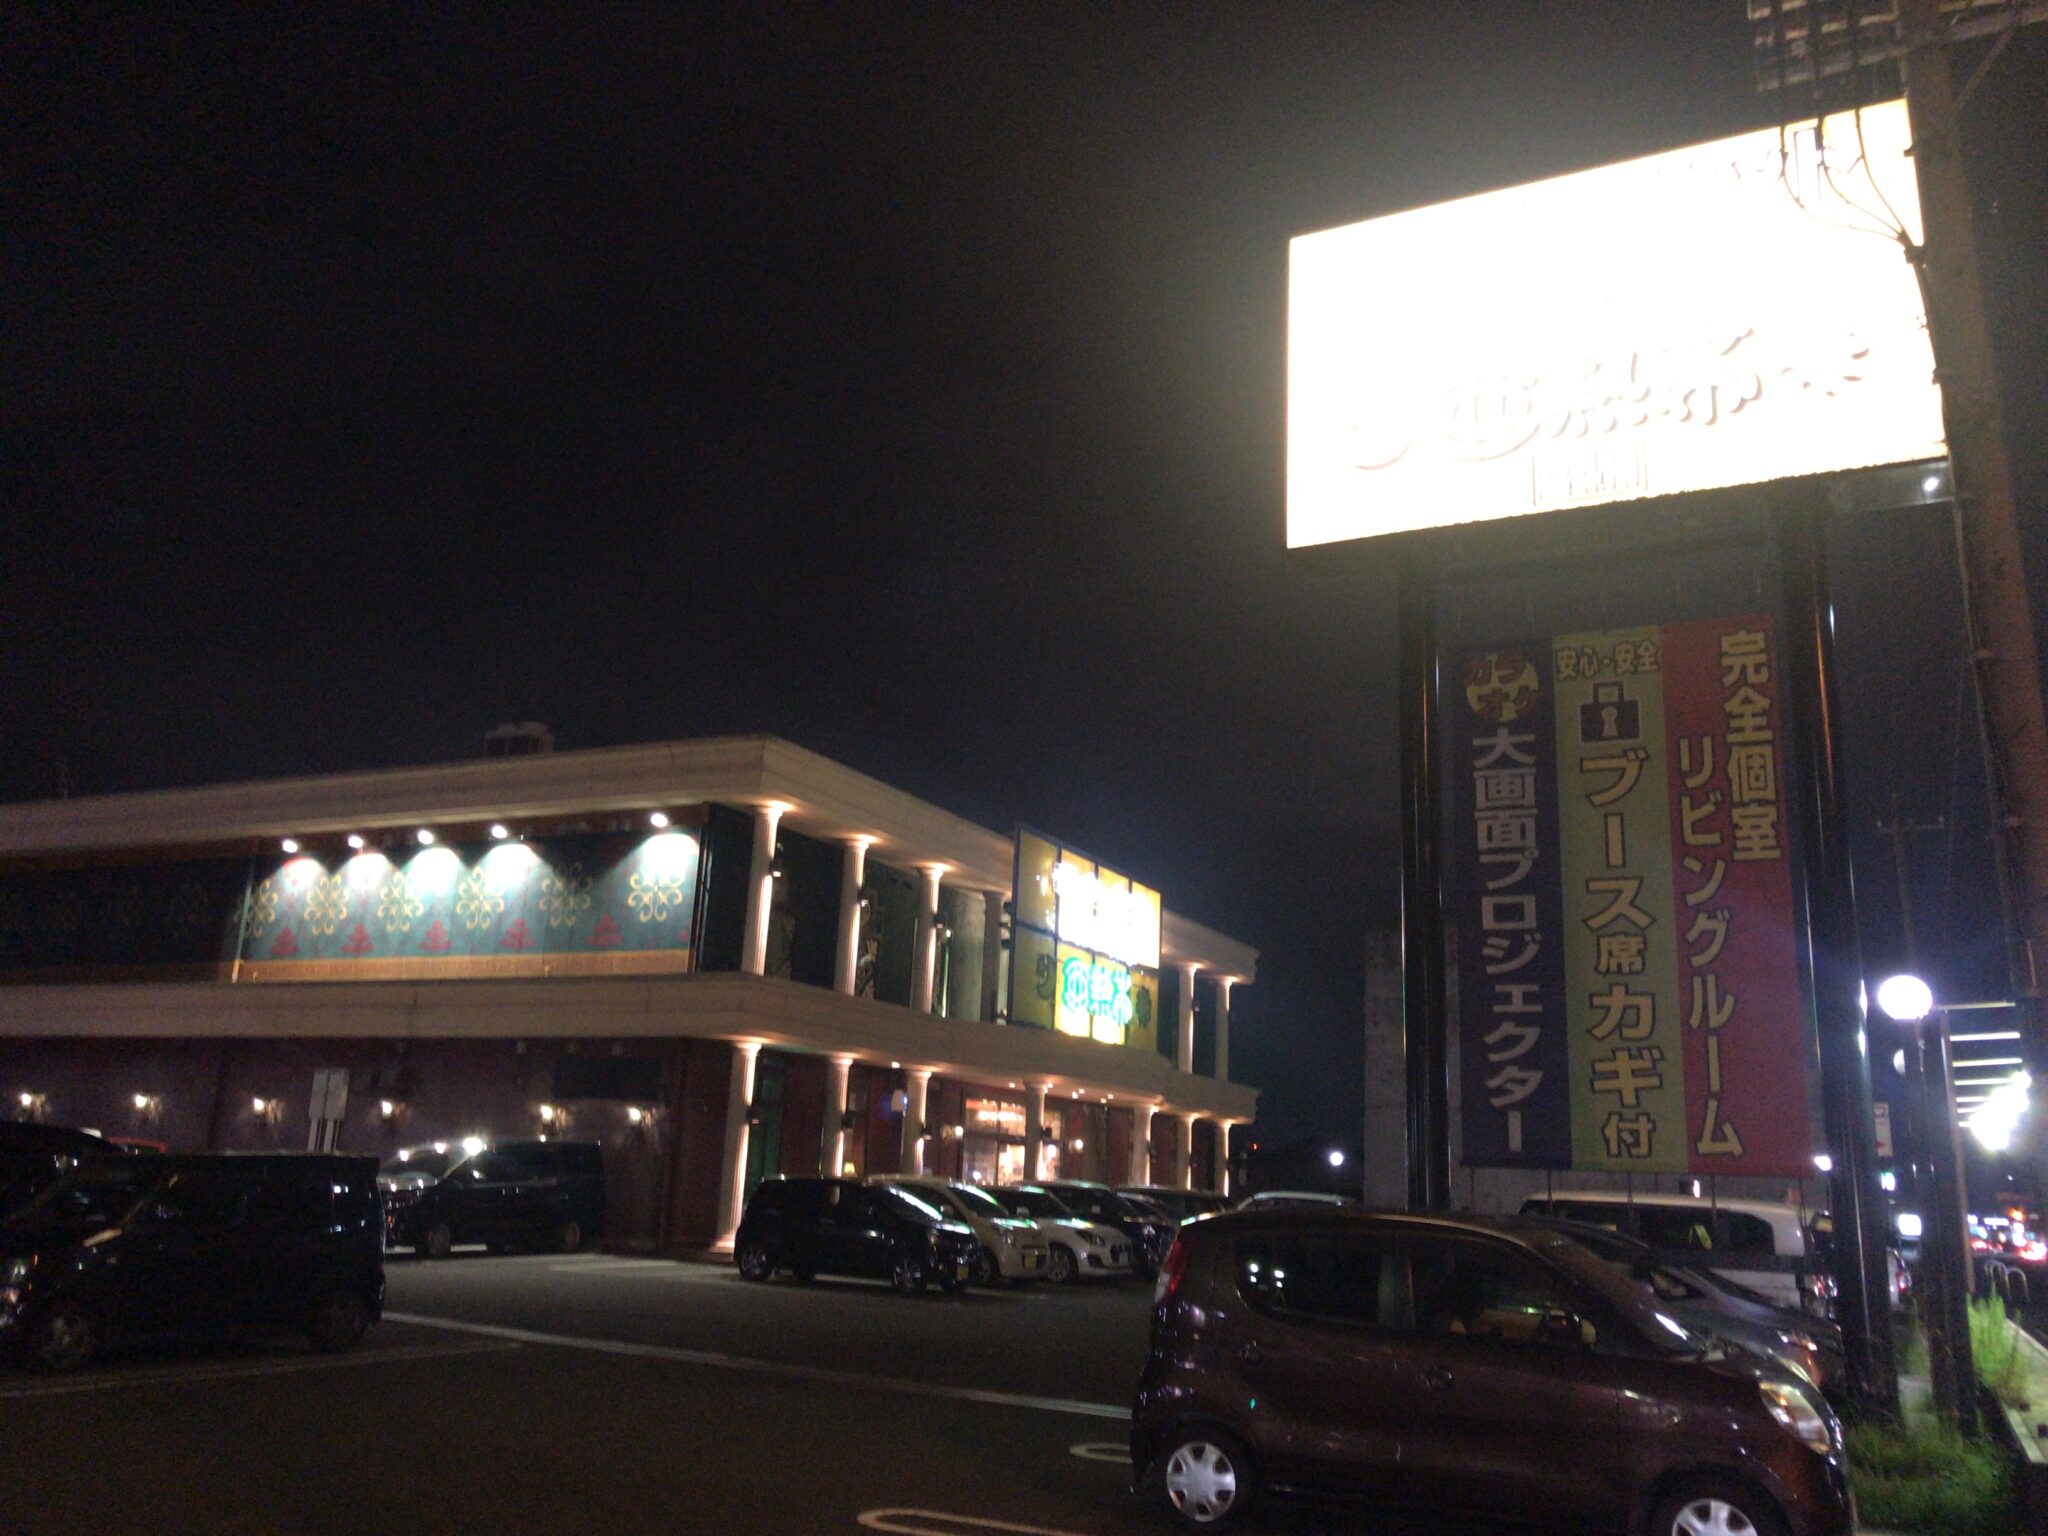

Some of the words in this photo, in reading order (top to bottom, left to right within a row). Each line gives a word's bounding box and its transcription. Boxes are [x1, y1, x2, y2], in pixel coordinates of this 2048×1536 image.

[1472, 727, 1545, 1152] 大画面プロジェクター
[1579, 746, 1666, 1159] ブース席カギ付
[1678, 734, 1744, 1158] リビングルーム
[1719, 630, 1782, 861] 完全個室
